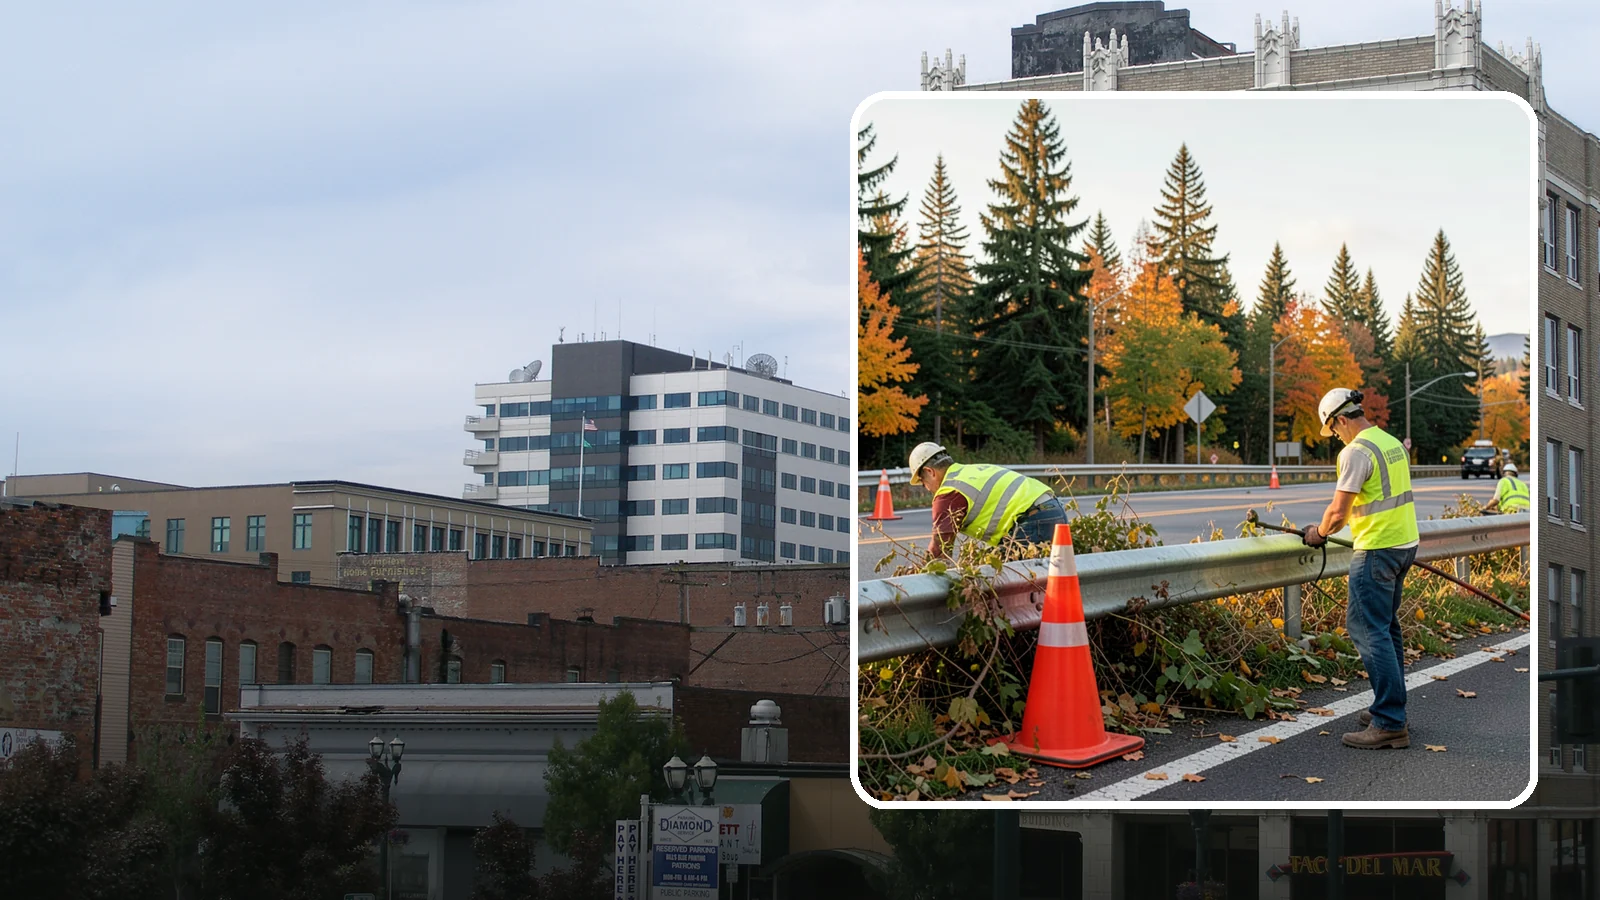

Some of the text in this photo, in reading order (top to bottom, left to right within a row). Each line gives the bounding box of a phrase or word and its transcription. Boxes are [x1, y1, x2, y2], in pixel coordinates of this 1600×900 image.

[343, 566, 427, 577] Home Furnishers
[660, 818, 713, 833] DIAMOND
[1022, 815, 1070, 828] BUILDING
[656, 845, 716, 854] RESERVED PARKING
[616, 825, 625, 894] PAY HERE
[627, 825, 637, 893] PAY HERE
[721, 851, 739, 861] Soup
[671, 862, 701, 870] PATRONS
[1289, 855, 1442, 877] TAC DEL MAR
[660, 888, 710, 898] PUBLIC PARKING
